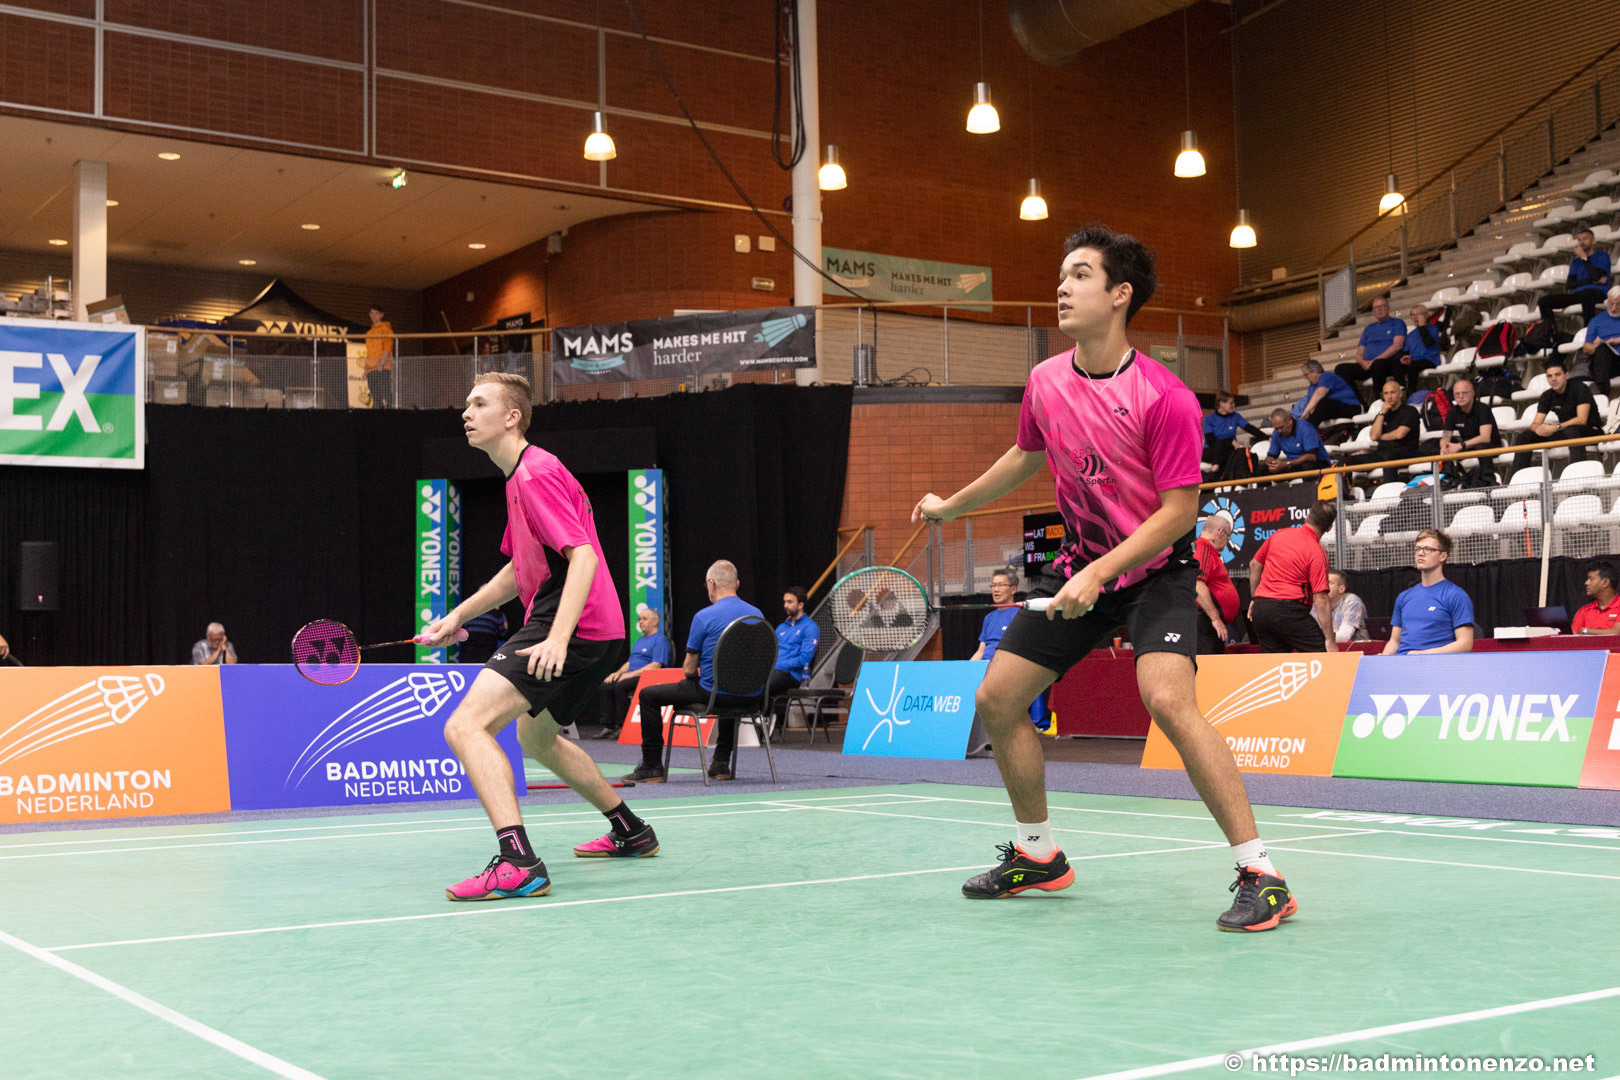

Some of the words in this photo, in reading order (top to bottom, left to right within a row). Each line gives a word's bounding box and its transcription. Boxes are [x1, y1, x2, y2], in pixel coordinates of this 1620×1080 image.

[826, 256, 876, 277] MAMS
[890, 281, 924, 295] harder
[891, 272, 922, 283] MAKES
[923, 275, 936, 285] ME
[937, 277, 952, 286] HIT
[292, 321, 350, 343] YONEX
[653, 334, 699, 350] MAKES
[701, 333, 720, 346] ME
[722, 331, 747, 344] HIT
[563, 332, 634, 357] MAMS
[653, 348, 703, 366] harder
[1250, 507, 1286, 524] BWF
[1288, 506, 1310, 520] Tou
[1033, 528, 1045, 539] LAT
[1254, 526, 1276, 541] Sup
[635, 518, 657, 590] YONEX
[1024, 541, 1035, 551] WS
[421, 526, 441, 597] YONEX
[448, 528, 460, 597] YONEX
[1034, 552, 1046, 562] FRA
[903, 695, 961, 712] DATAWEB
[1438, 693, 1580, 742] YONEX
[1225, 736, 1306, 754] DMINTON
[1232, 753, 1290, 769] ERLAND
[0, 769, 172, 796] BADMINTON
[344, 778, 462, 798] NEDERLAND
[17, 792, 154, 815] NEDERLAND
